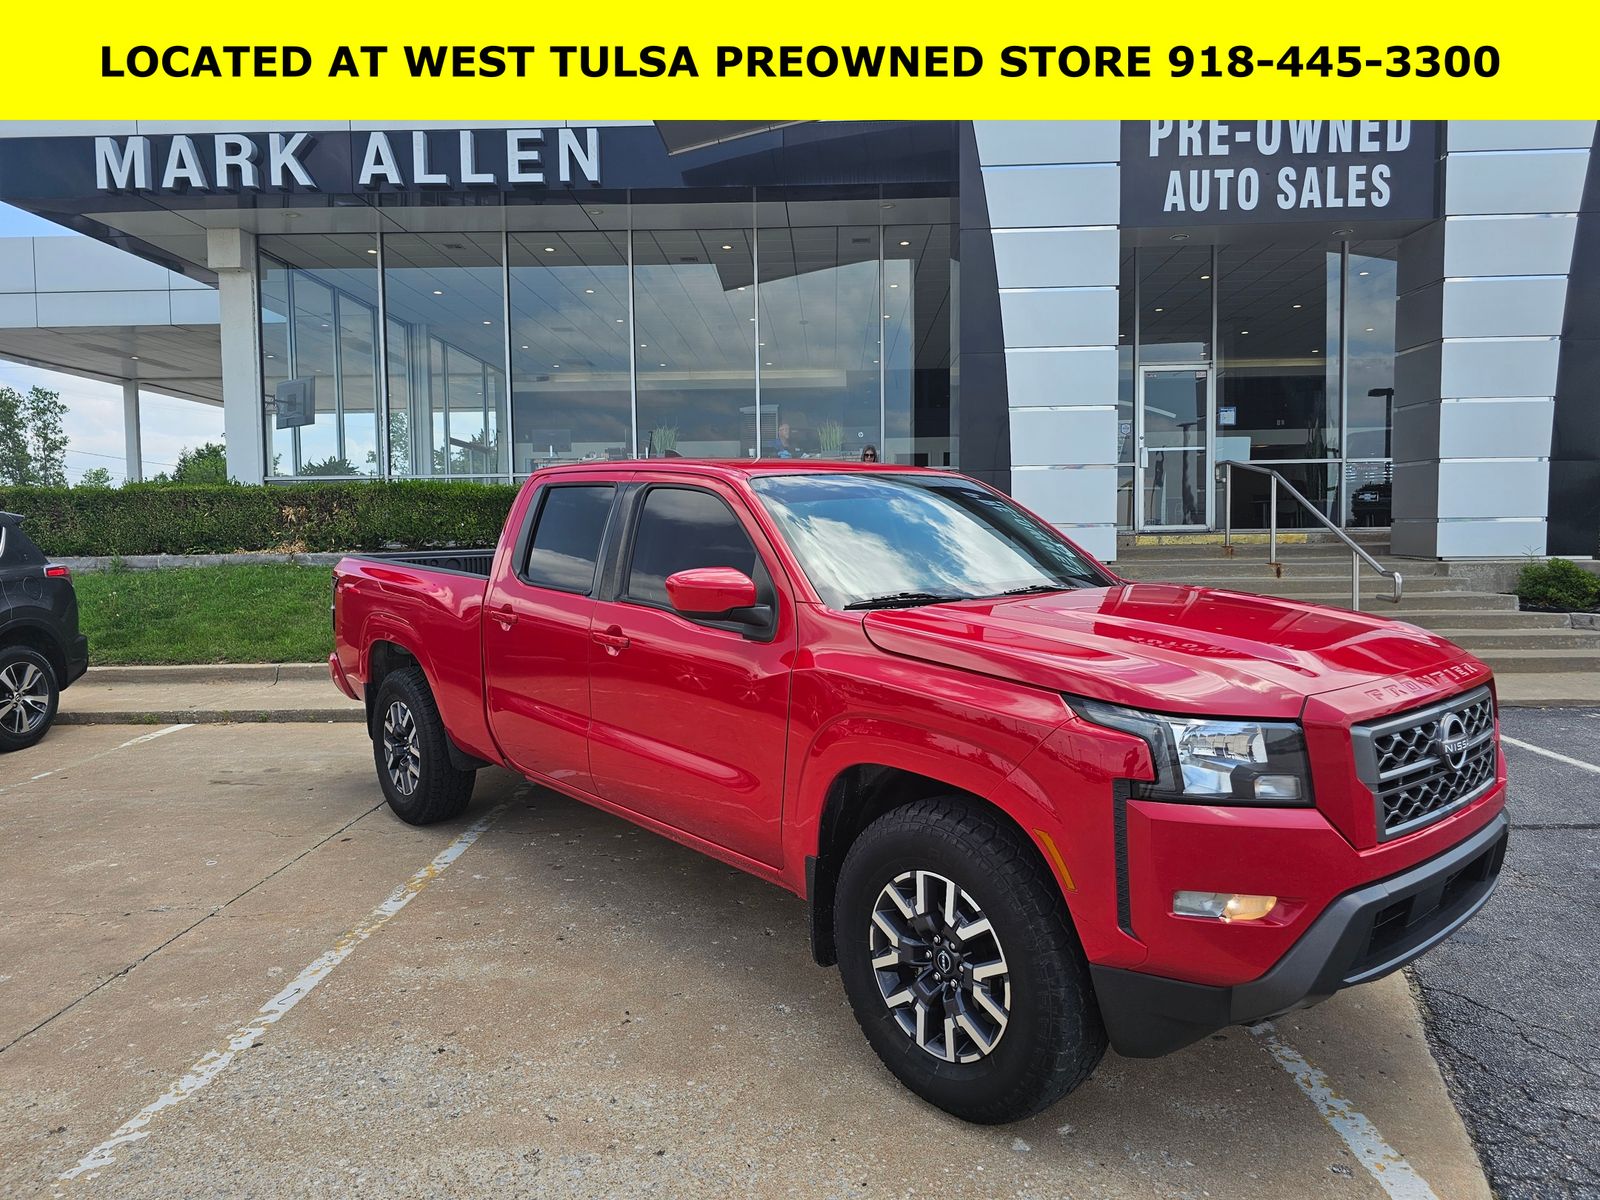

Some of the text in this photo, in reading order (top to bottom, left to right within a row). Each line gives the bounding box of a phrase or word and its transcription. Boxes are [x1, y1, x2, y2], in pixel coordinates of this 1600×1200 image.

[1149, 120, 1411, 157] PRE-OWNED
[95, 127, 601, 190] MARK ALLEN
[1163, 164, 1391, 212] AUTO SALES
[1364, 662, 1478, 701] FRONTIER
[1444, 738, 1471, 753] NISS
